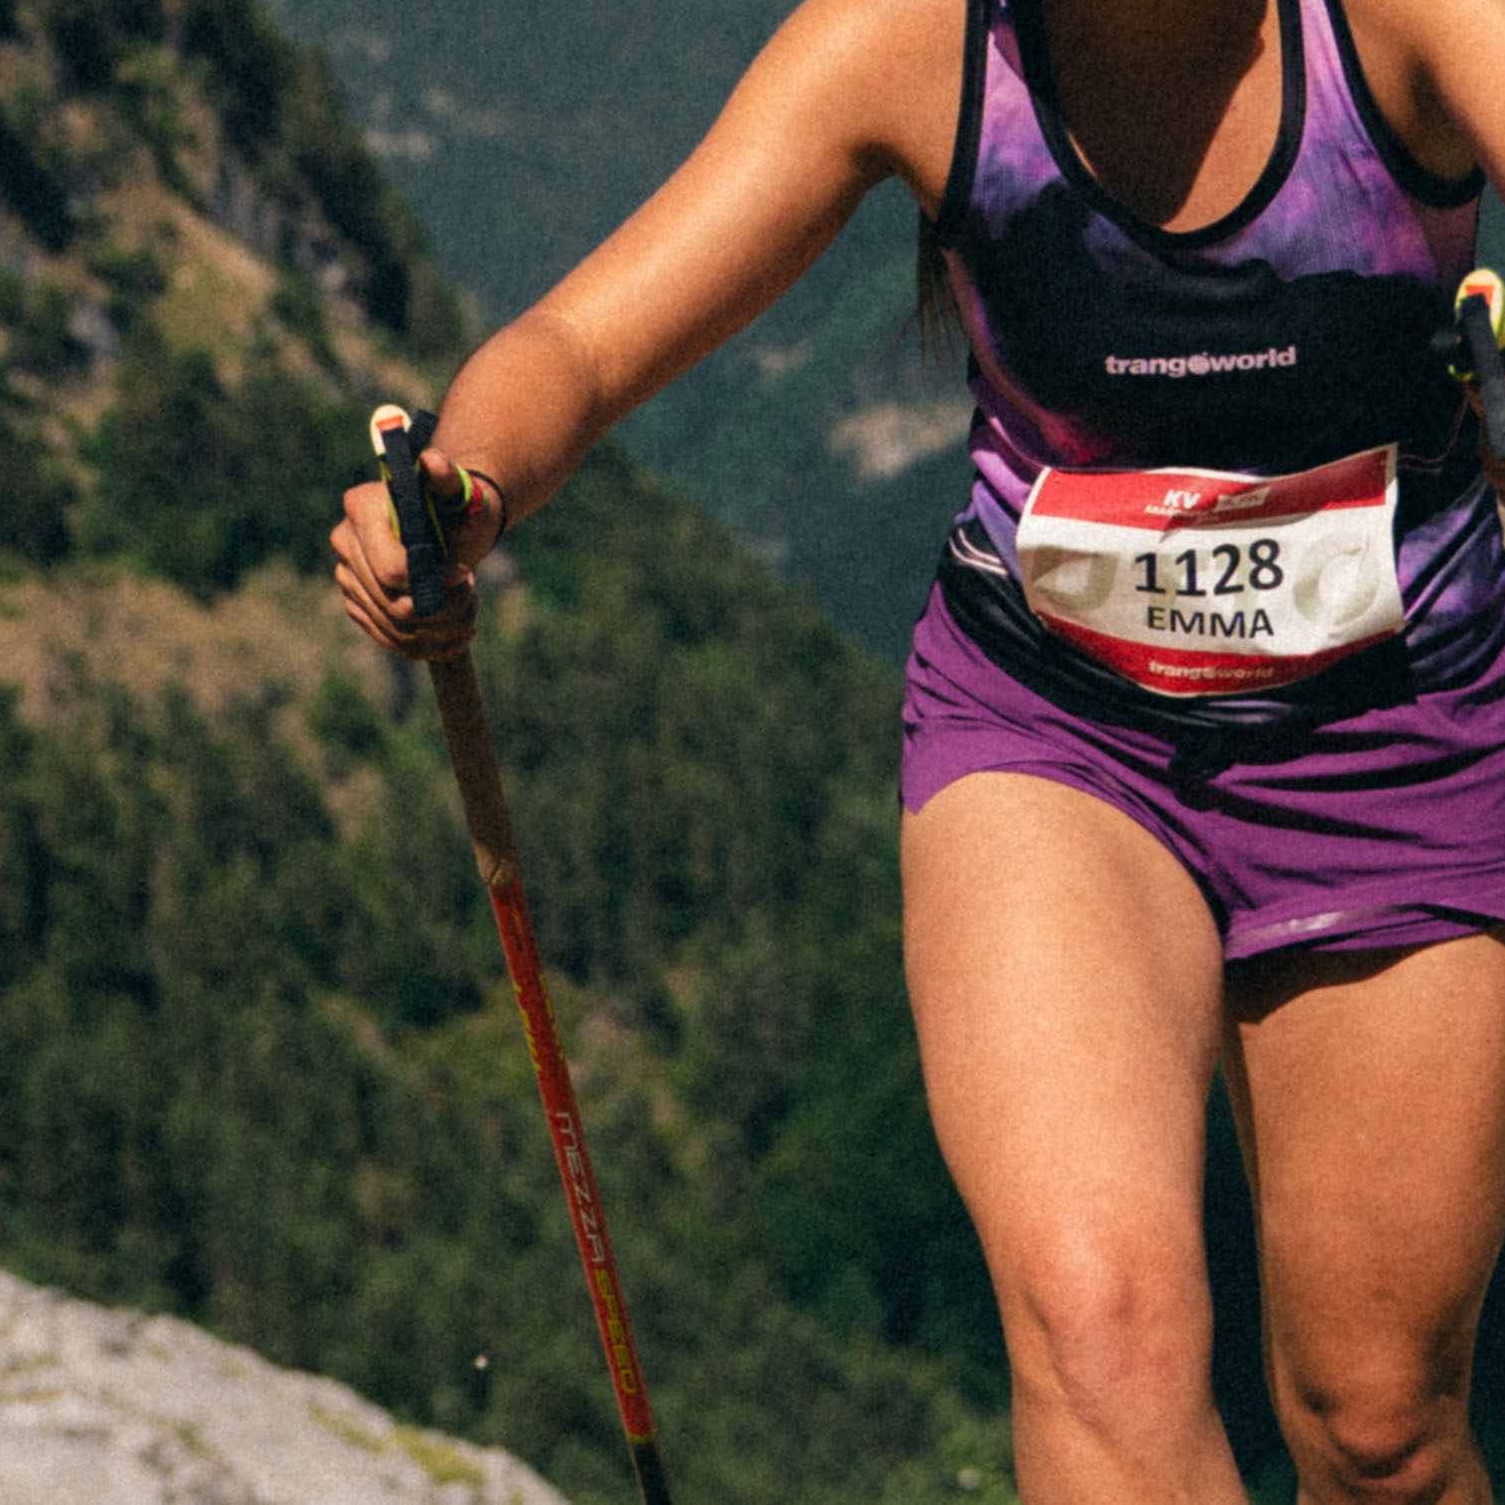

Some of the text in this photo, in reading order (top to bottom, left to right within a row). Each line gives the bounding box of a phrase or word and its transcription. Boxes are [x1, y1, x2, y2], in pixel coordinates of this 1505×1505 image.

[1162, 489, 1202, 509] KV
[1133, 538, 1284, 597] 1128
[1147, 606, 1275, 639] EMMA
[555, 1111, 638, 1395] MEZZA SPEED
